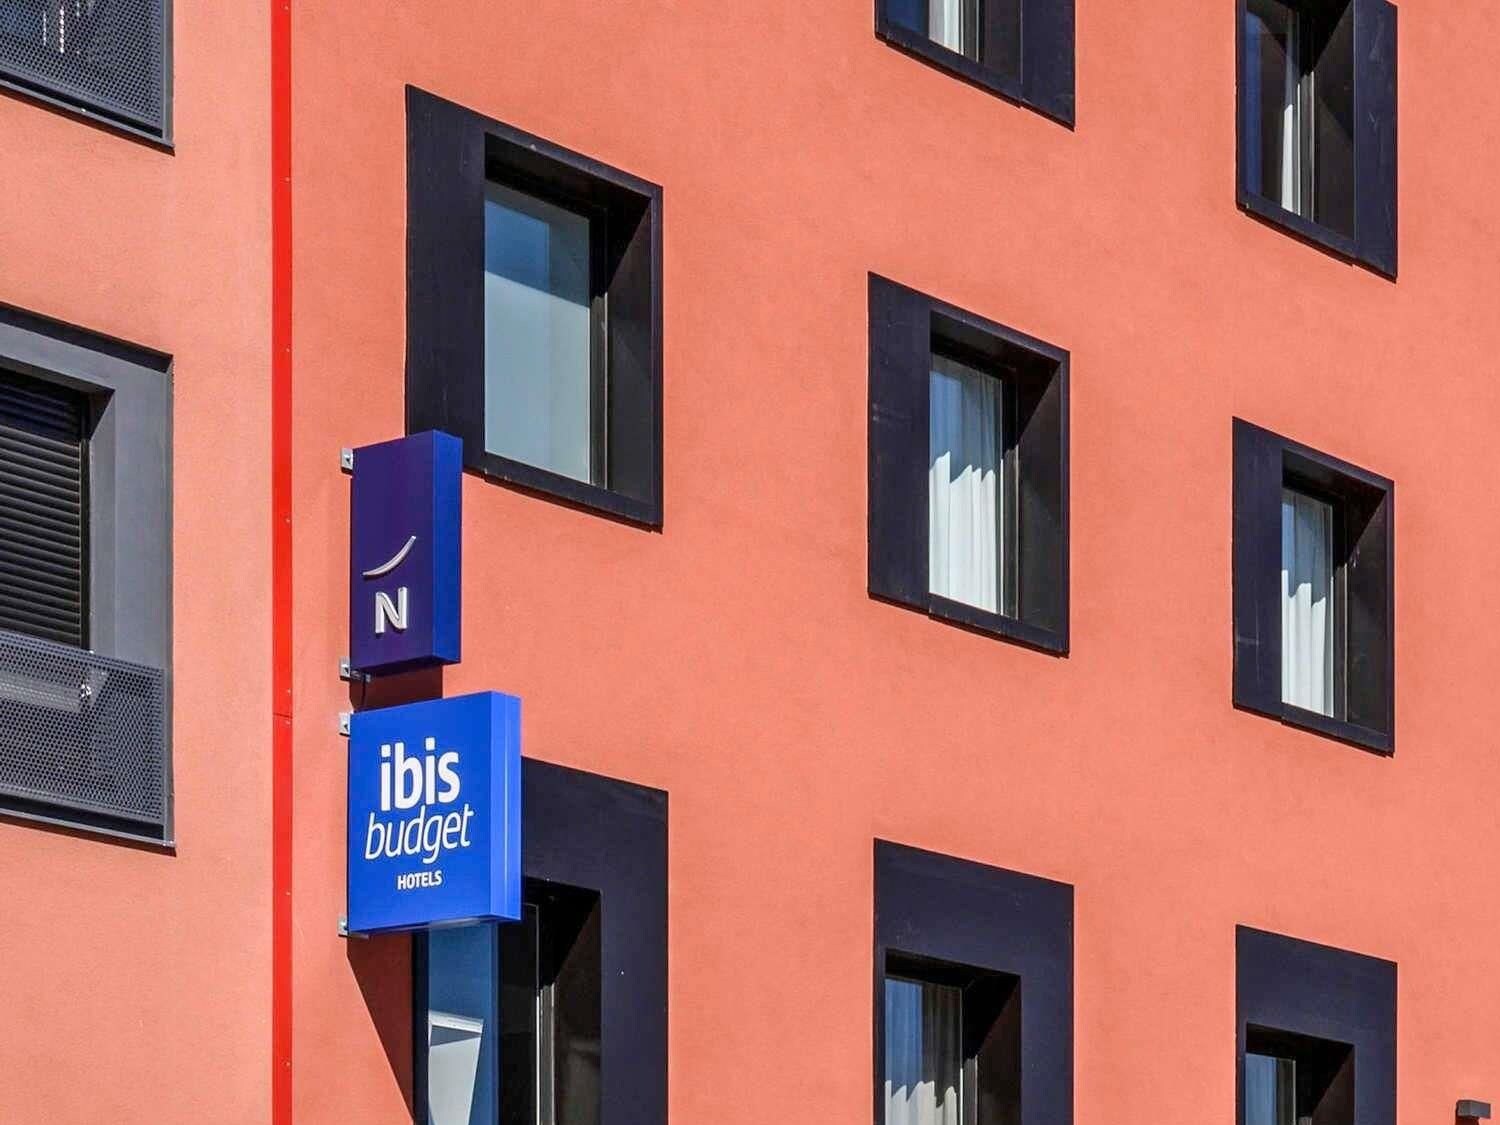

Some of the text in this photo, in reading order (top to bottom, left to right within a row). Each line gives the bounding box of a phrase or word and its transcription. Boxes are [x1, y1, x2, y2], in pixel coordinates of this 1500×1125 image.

[375, 586, 408, 634] N
[380, 737, 461, 811] ibis
[364, 803, 474, 864] budget
[397, 869, 442, 891] HOTELS
